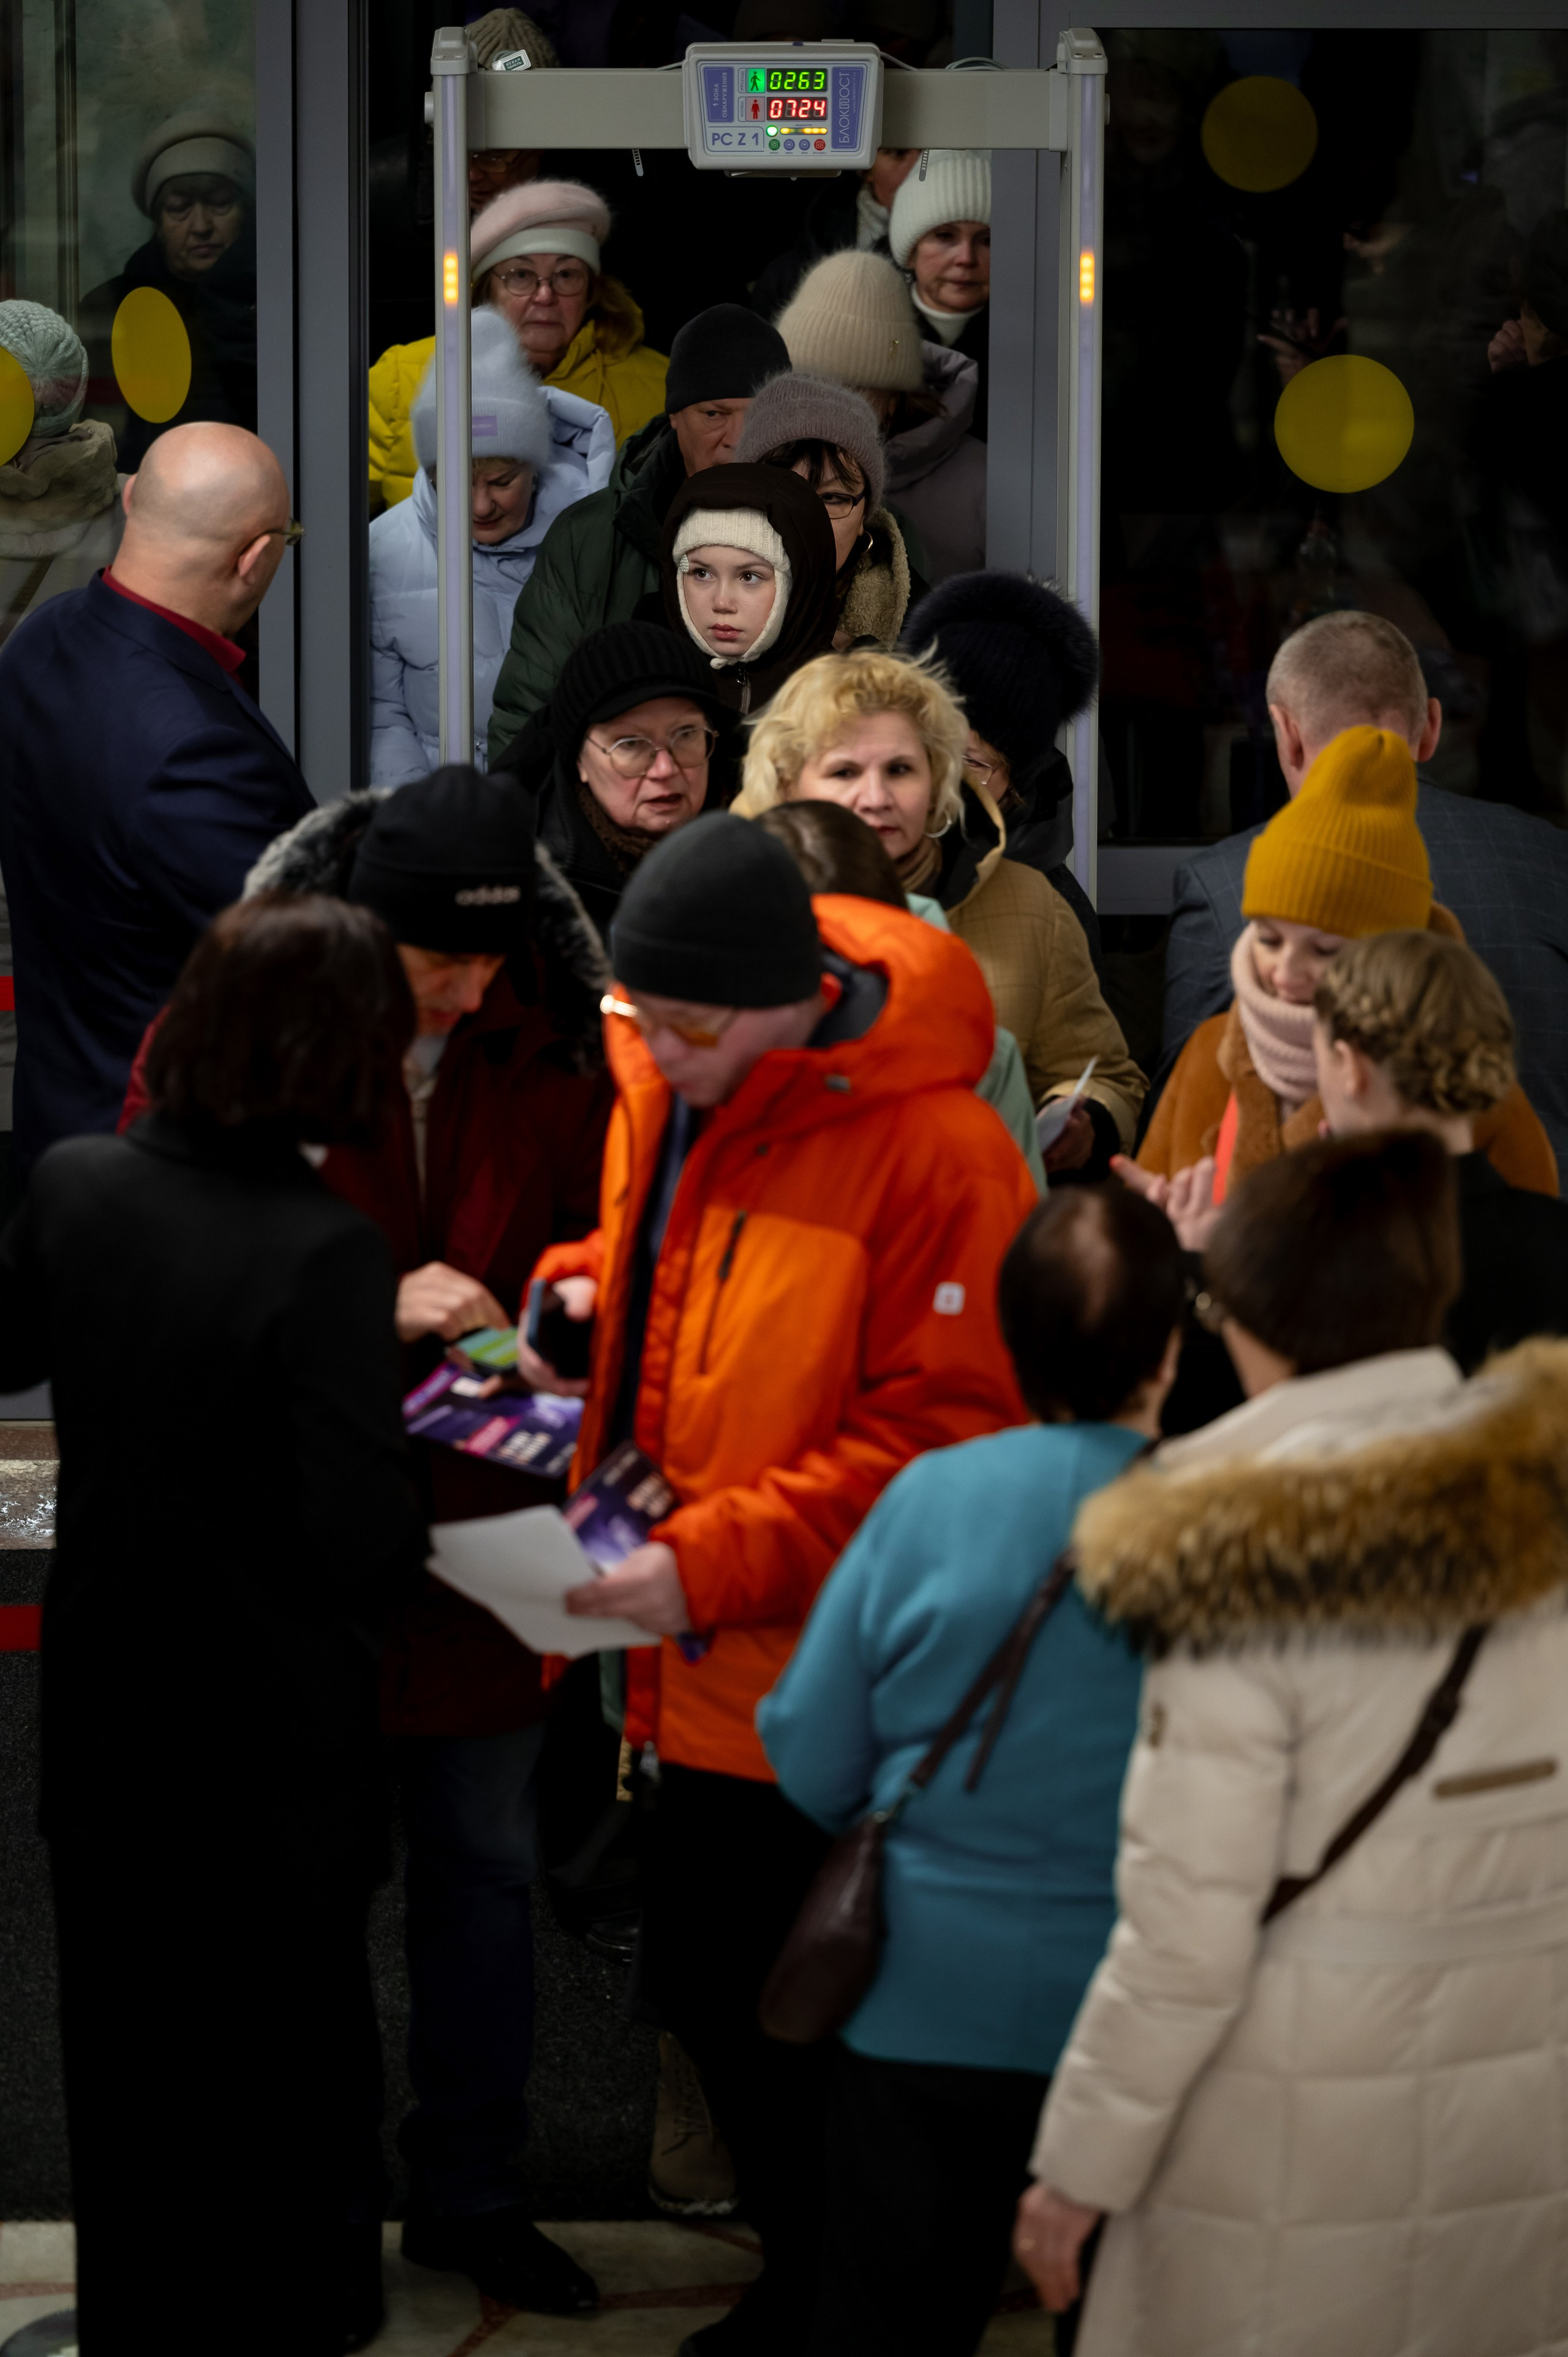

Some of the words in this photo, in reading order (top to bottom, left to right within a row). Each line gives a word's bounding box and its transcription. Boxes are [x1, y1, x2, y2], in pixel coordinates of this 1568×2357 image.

[769, 72, 825, 90] 0263
[769, 99, 826, 119] 0724
[839, 72, 850, 143] БЛОКПОСТ
[712, 132, 733, 146] PC
[737, 132, 746, 146] Z
[752, 132, 759, 146] 1
